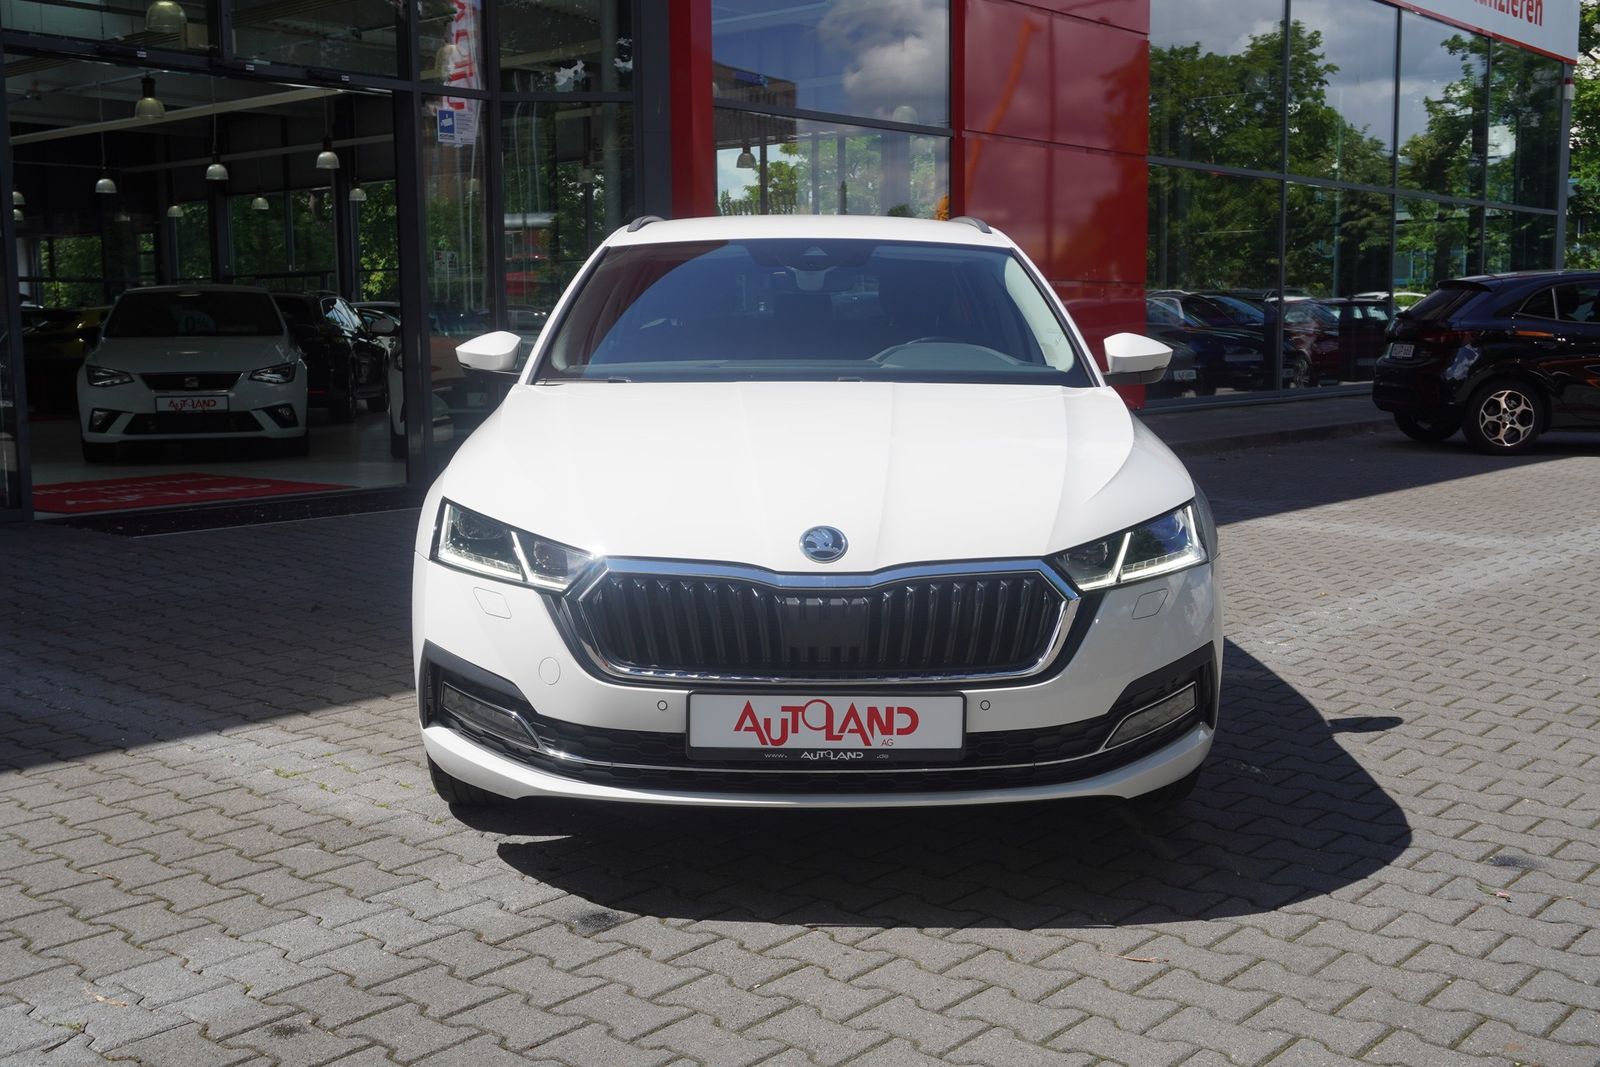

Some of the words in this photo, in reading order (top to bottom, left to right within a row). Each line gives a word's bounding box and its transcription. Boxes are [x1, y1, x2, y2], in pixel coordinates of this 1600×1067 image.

[733, 699, 920, 747] AUTOLAND
[881, 739, 894, 747] AG
[800, 749, 864, 760] AUTOLAND
